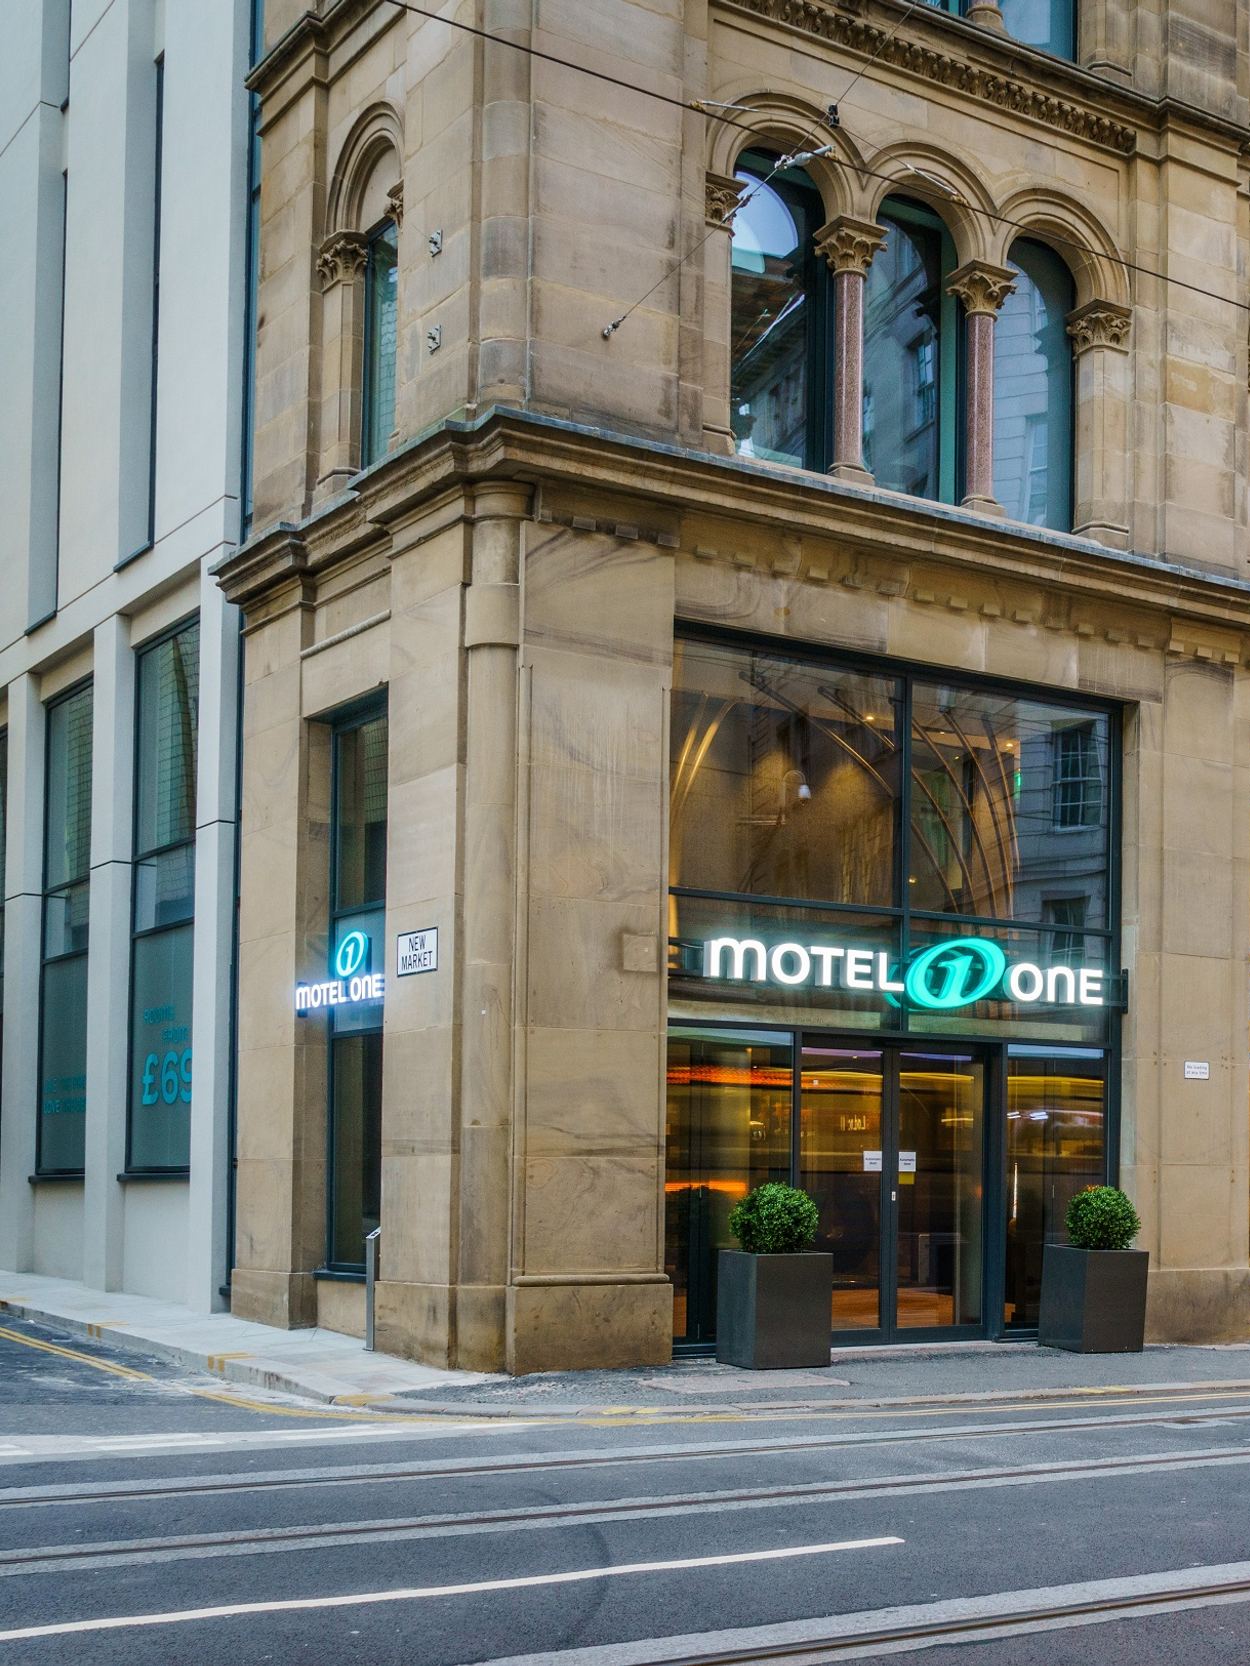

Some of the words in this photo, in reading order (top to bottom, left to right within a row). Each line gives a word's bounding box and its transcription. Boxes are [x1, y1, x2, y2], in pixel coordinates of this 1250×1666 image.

[401, 951, 433, 971] MARKET
[408, 934, 427, 952] NEW
[708, 937, 906, 993] MOTEL
[1008, 962, 1104, 1005] ONE
[296, 981, 346, 1010] MOTEL
[349, 974, 383, 1002] ONE
[142, 1047, 192, 1106] £69
